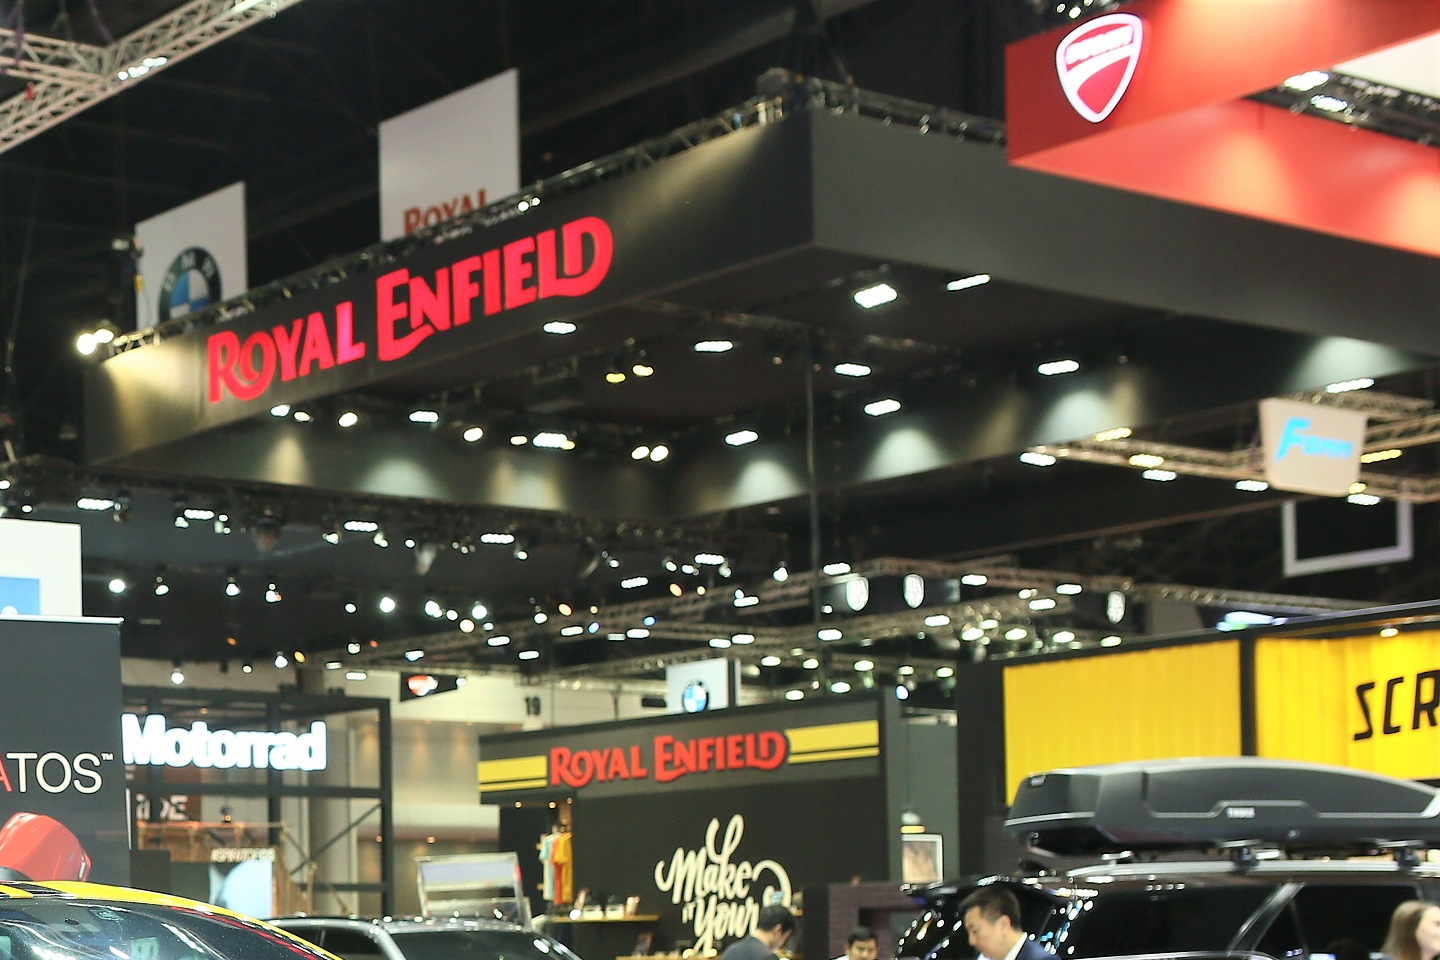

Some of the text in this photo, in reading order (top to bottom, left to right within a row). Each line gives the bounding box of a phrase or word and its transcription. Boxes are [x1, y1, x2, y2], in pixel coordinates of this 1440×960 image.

[207, 216, 614, 403] ROYAL ENFIELD
[121, 713, 327, 771] Motorrad
[550, 730, 787, 788] ROYAL ENFIELD
